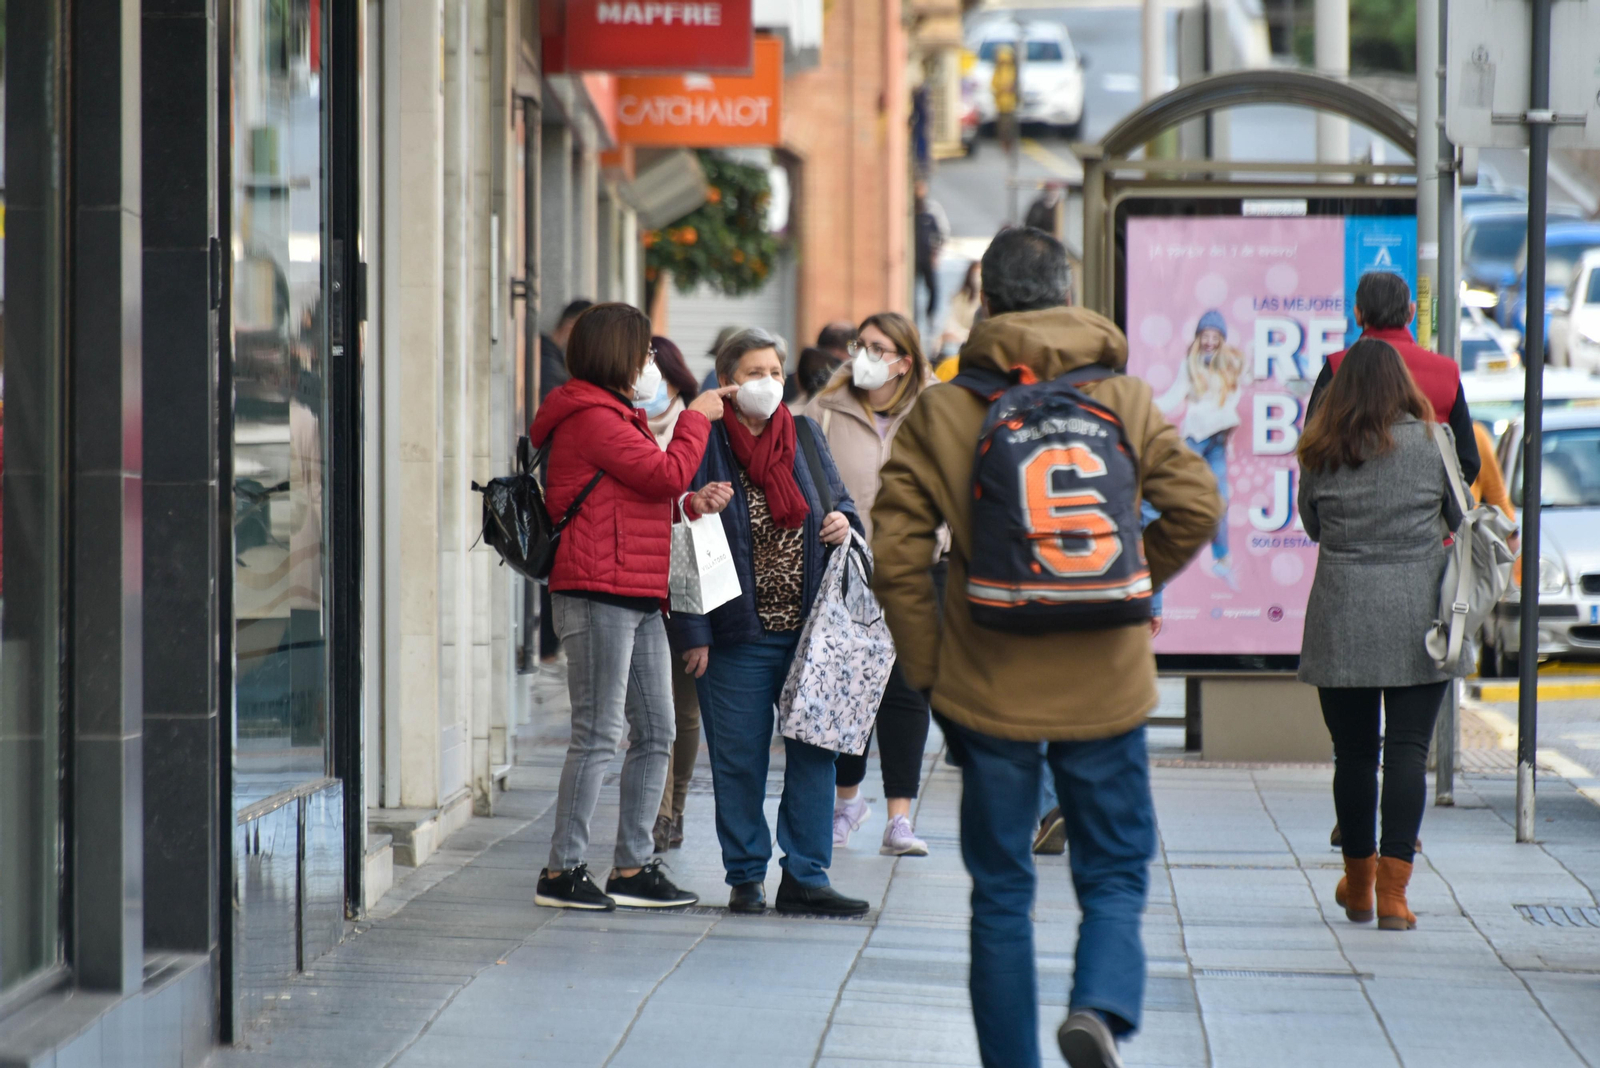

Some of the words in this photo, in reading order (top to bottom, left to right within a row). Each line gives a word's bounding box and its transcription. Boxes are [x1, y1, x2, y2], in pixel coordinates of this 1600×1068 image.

[597, 2, 722, 27] MAPFRE
[618, 95, 772, 127] CATCHALOT
[1253, 298, 1279, 311] LAS
[1283, 298, 1351, 312] MEJORES
[1014, 418, 1100, 443] PLAYOFF
[1018, 442, 1123, 578] 6
[1252, 537, 1281, 548] SOLO
[702, 553, 727, 571] VILLATORO
